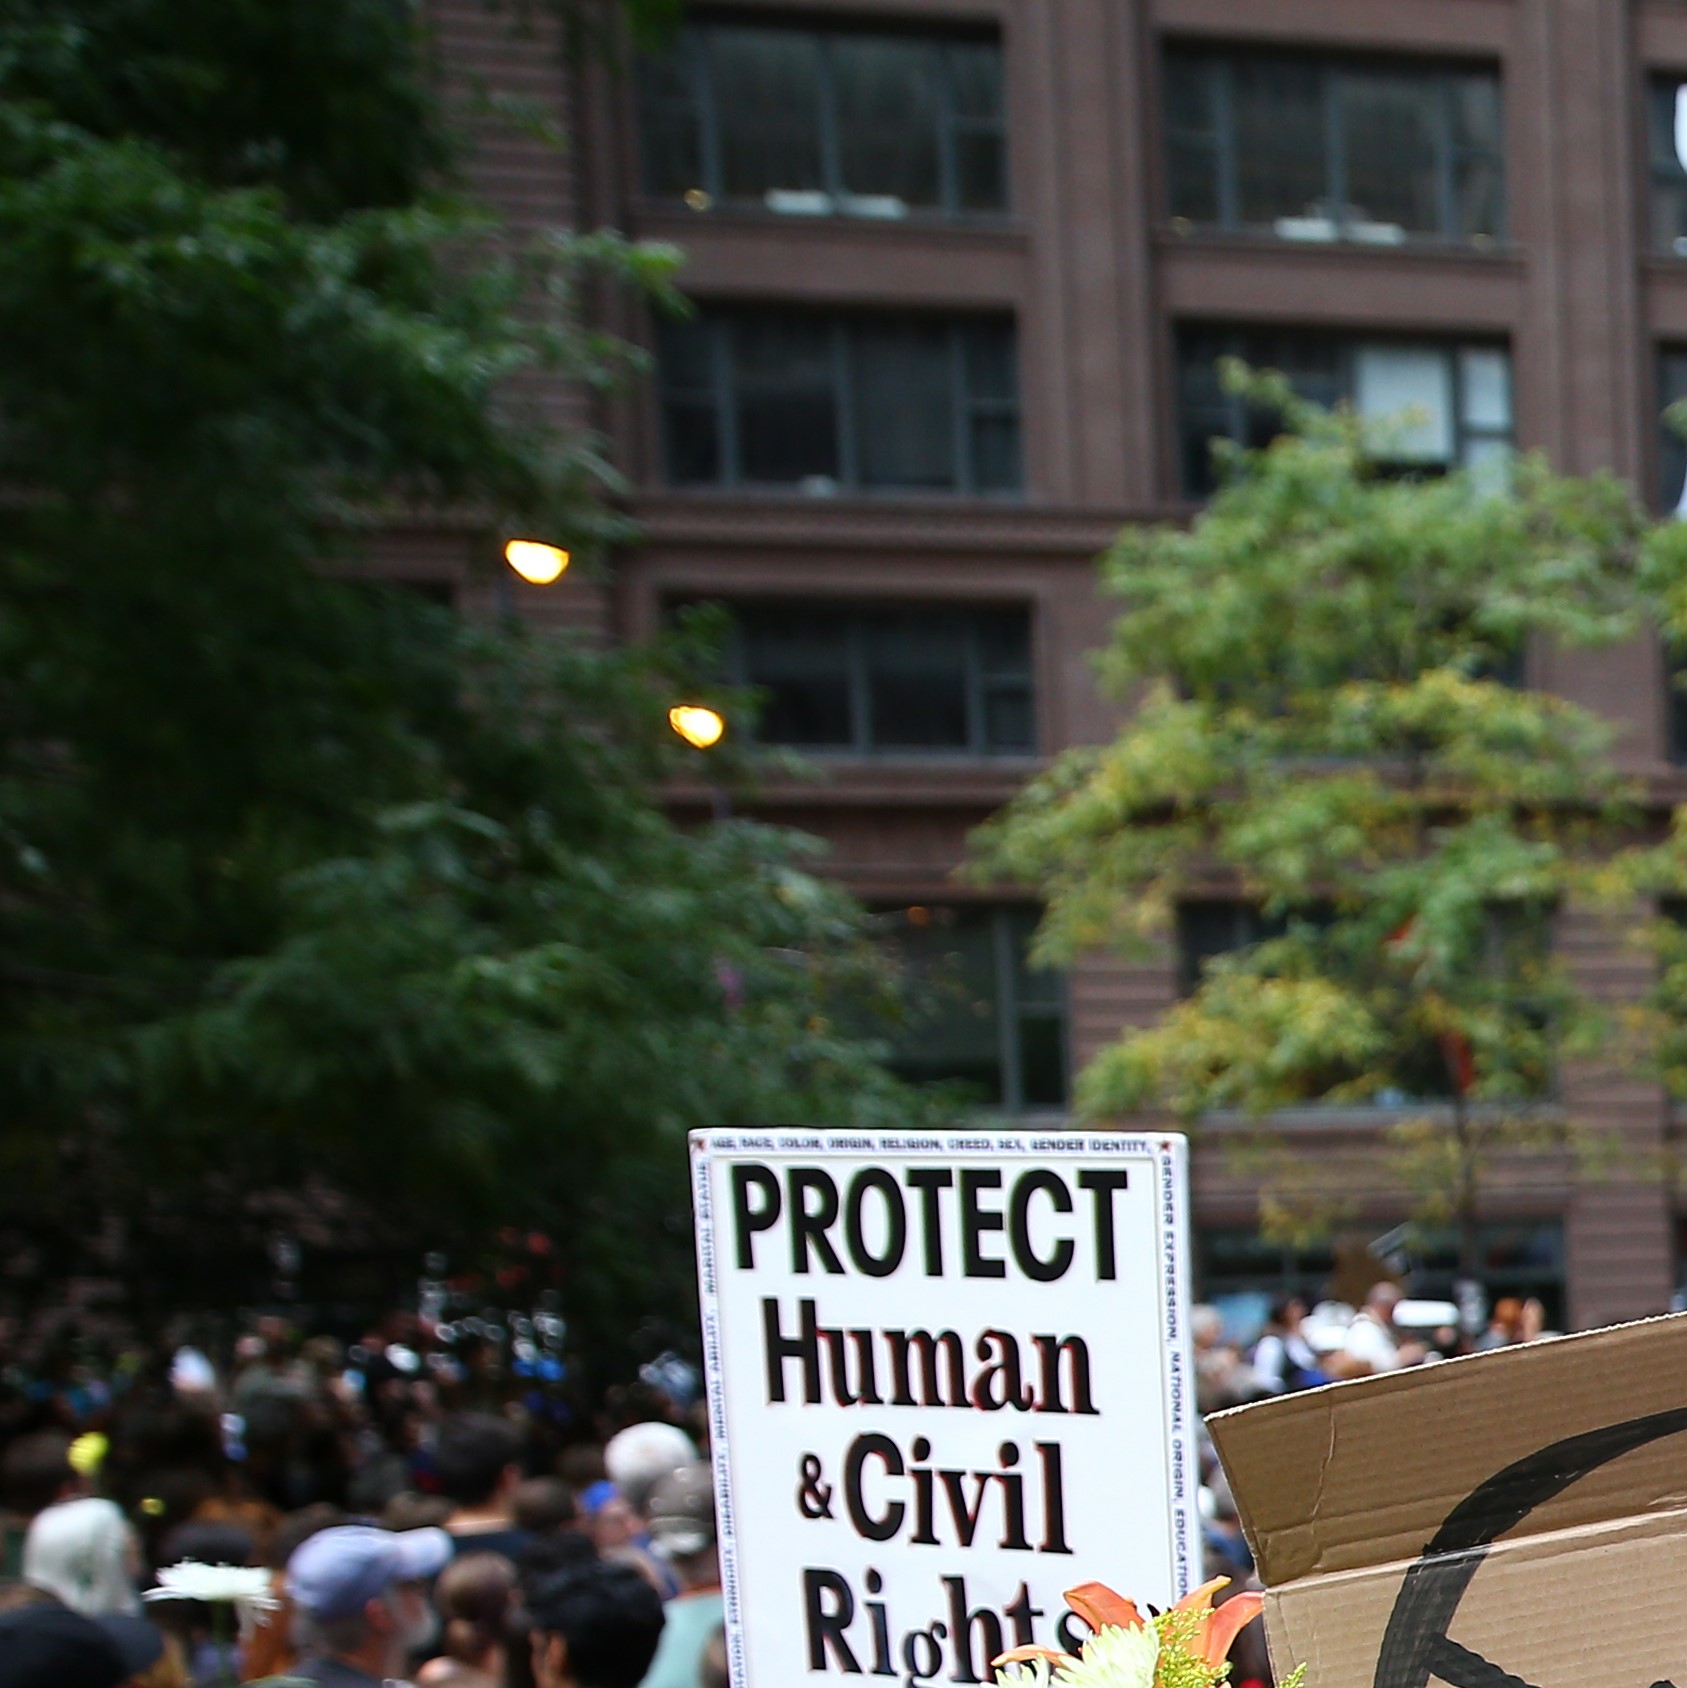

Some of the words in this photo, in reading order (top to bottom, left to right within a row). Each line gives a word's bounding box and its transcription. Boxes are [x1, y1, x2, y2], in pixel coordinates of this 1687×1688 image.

[1032, 1140, 1084, 1152] GENDER
[1160, 1156, 1174, 1225] GENDER
[731, 1163, 1128, 1281] PROTECT
[1162, 1231, 1179, 1343] EXPRESSION,
[761, 1298, 1100, 1415] Human
[1168, 1351, 1182, 1433] NATIONAL
[795, 1453, 833, 1519] &
[844, 1434, 1074, 1554] Civil
[1170, 1439, 1185, 1502] ORIGIN,
